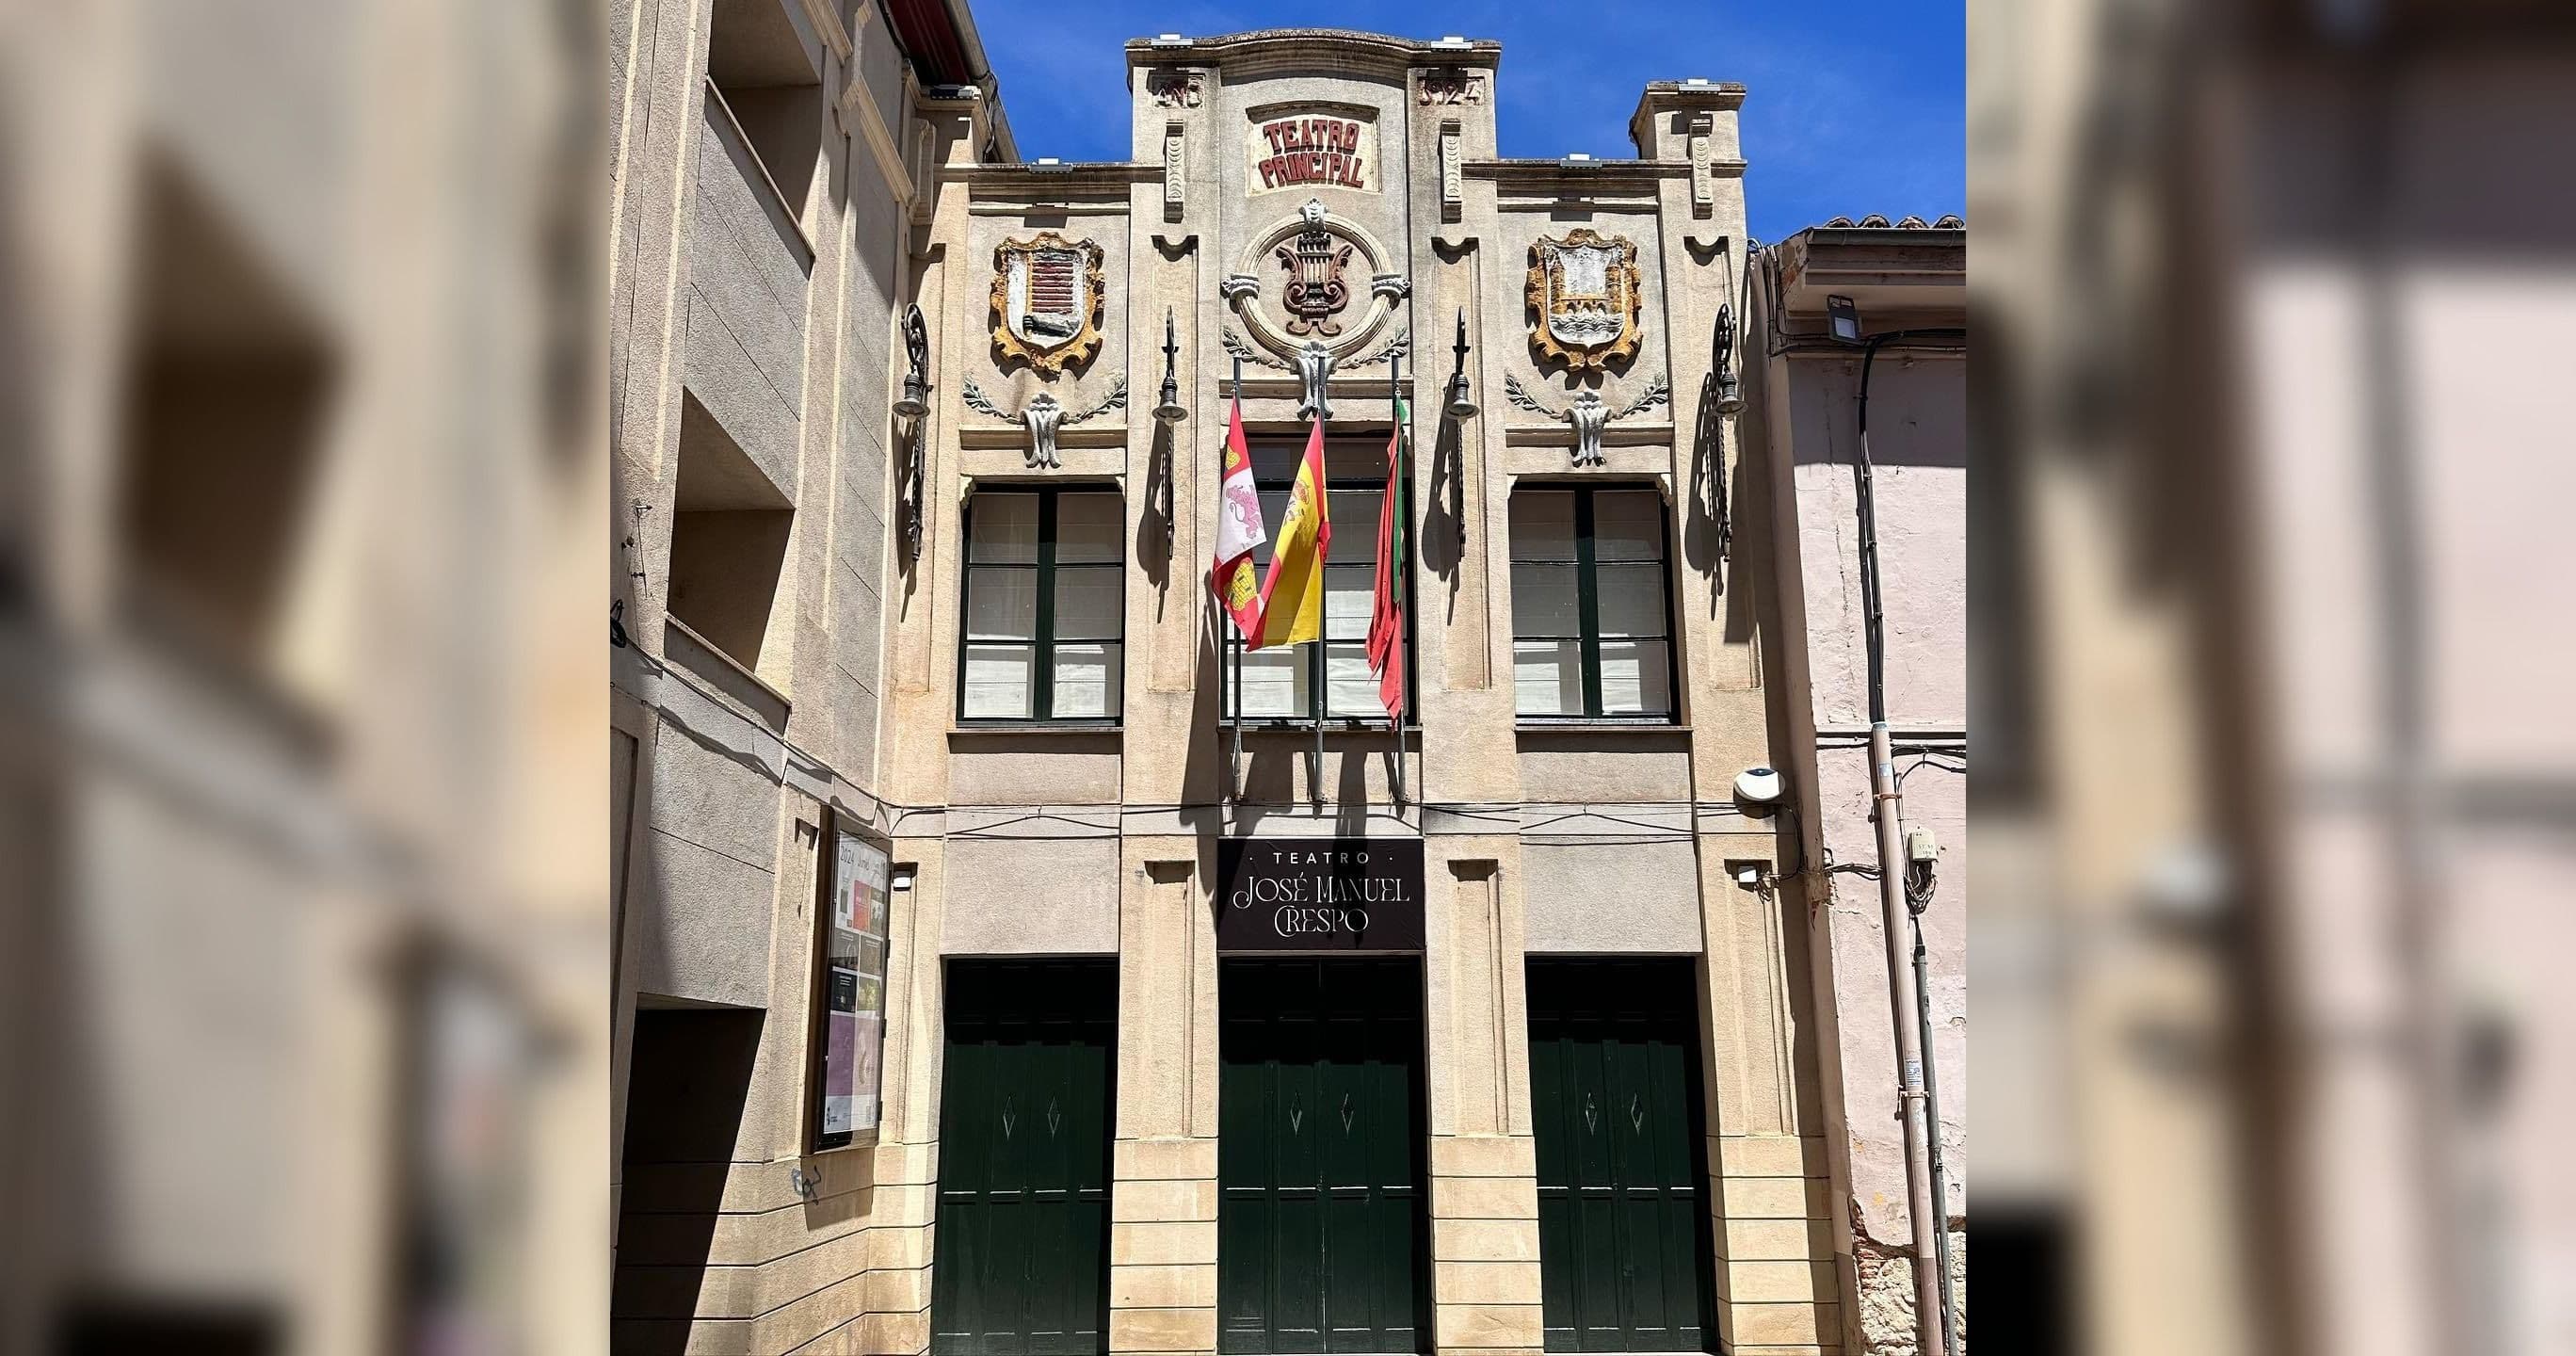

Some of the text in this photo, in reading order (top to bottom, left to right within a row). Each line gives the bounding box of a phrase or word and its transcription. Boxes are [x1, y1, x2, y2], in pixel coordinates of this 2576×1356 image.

[1263, 120, 1360, 155] TEATRO
[1258, 153, 1364, 188] PRINCIPAL
[1273, 852, 1369, 864] TEATRO
[1232, 871, 1410, 909] JOSÉ MANUEL
[1274, 905, 1369, 938] CRESPO
